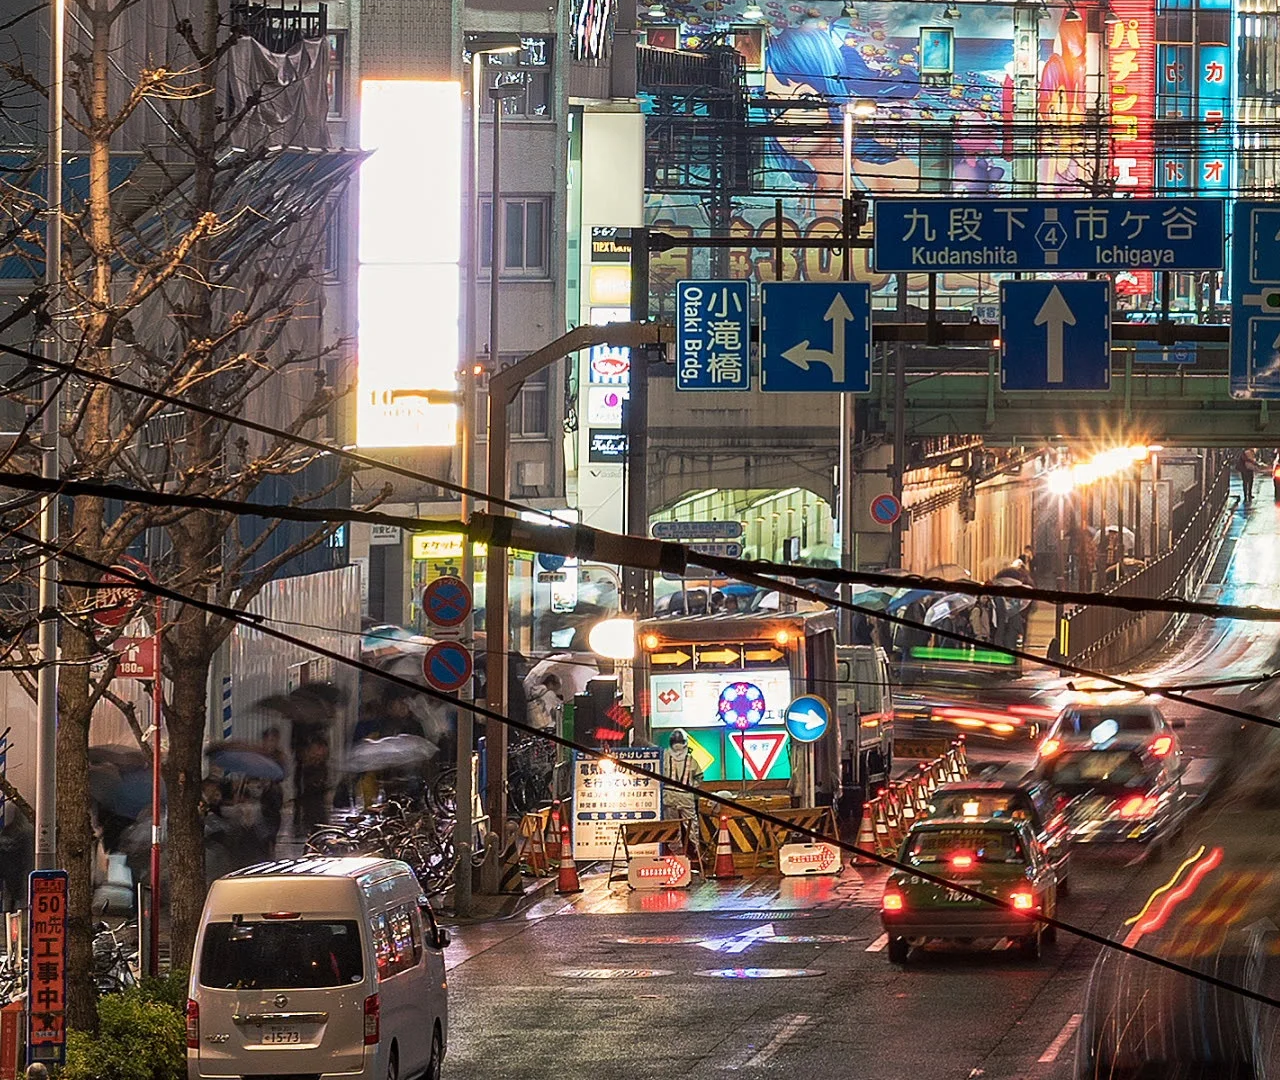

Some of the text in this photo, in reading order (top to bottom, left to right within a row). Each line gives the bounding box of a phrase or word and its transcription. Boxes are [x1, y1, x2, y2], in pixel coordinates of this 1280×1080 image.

[902, 208, 1028, 243] 九段下
[1044, 227, 1058, 246] 4
[911, 245, 1018, 266] Kudanshita
[1096, 245, 1175, 267] Ichigaya
[681, 286, 703, 385] Otaki Brdg.
[706, 286, 743, 384] 小滝橋
[119, 662, 144, 673] 180m
[749, 742, 770, 752] 徐行
[37, 895, 61, 912] 50
[36, 936, 60, 1007] 工事中
